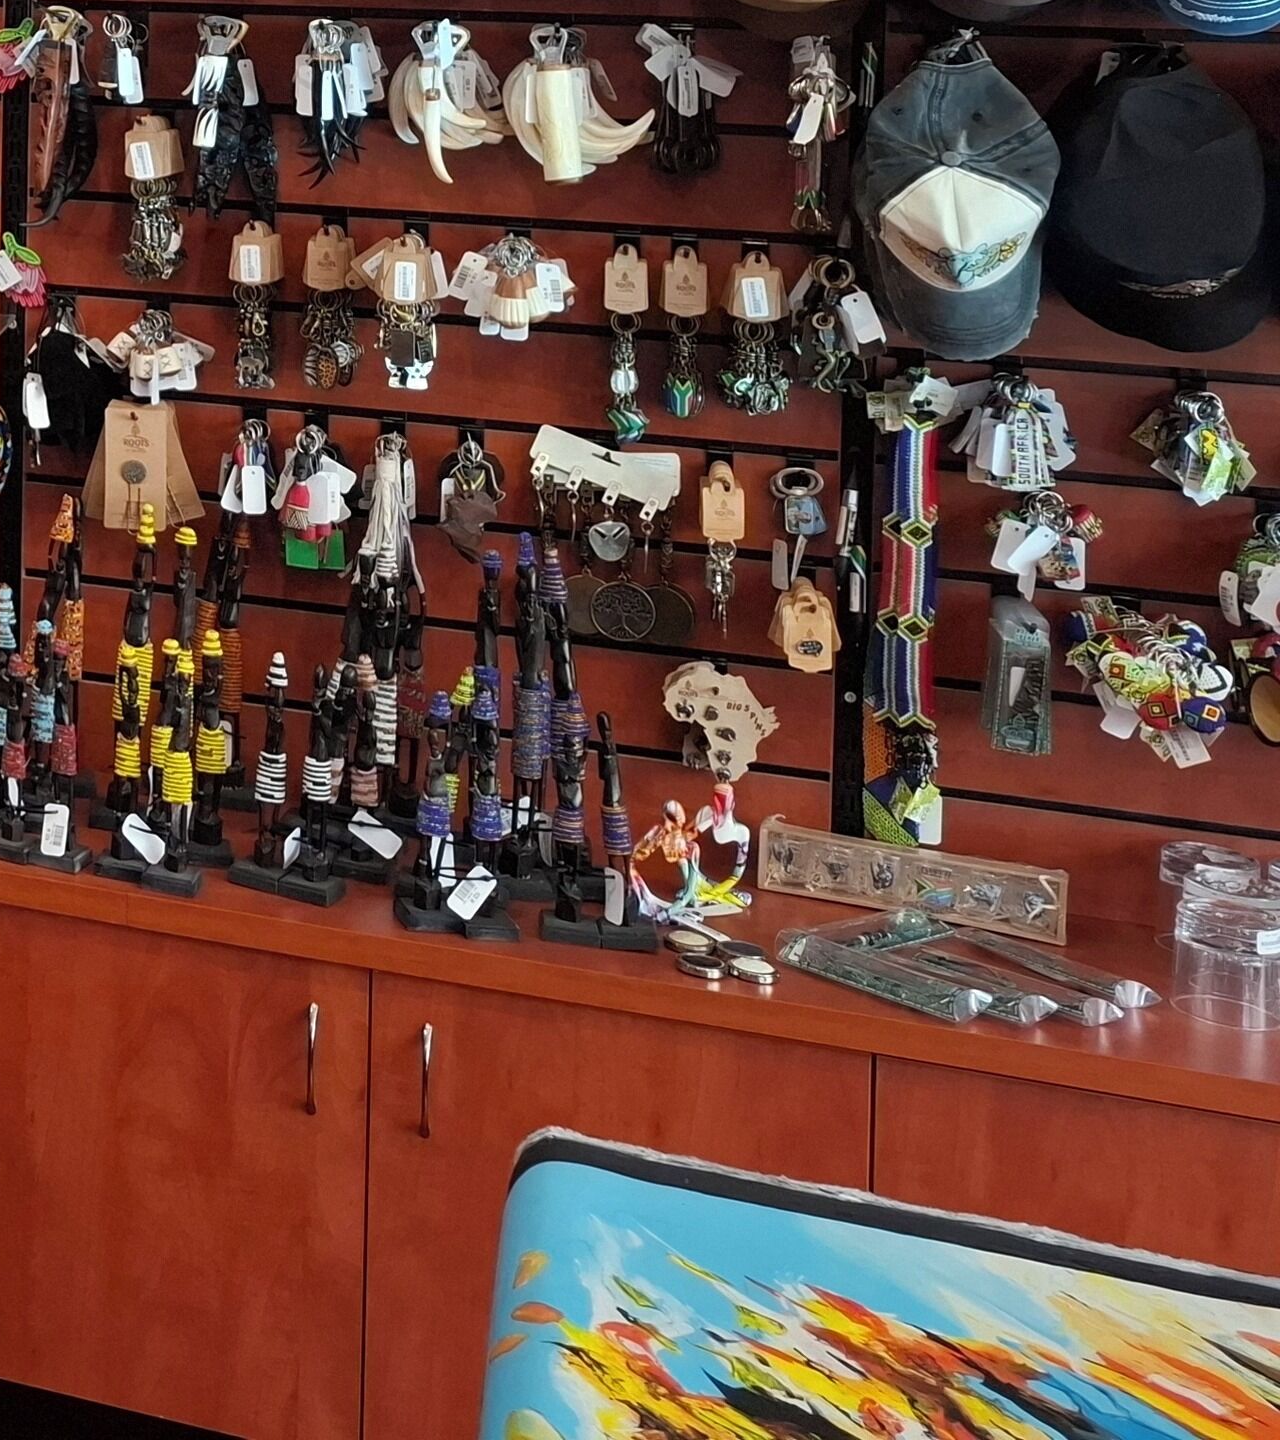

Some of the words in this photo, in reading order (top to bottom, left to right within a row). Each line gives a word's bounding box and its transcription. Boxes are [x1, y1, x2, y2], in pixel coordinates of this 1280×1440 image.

[123, 438, 150, 448] ROOTS
[1017, 418, 1030, 453] AFRICA
[1018, 454, 1031, 485] SOUTH
[726, 702, 742, 711] BIG
[749, 712, 767, 736] PINS
